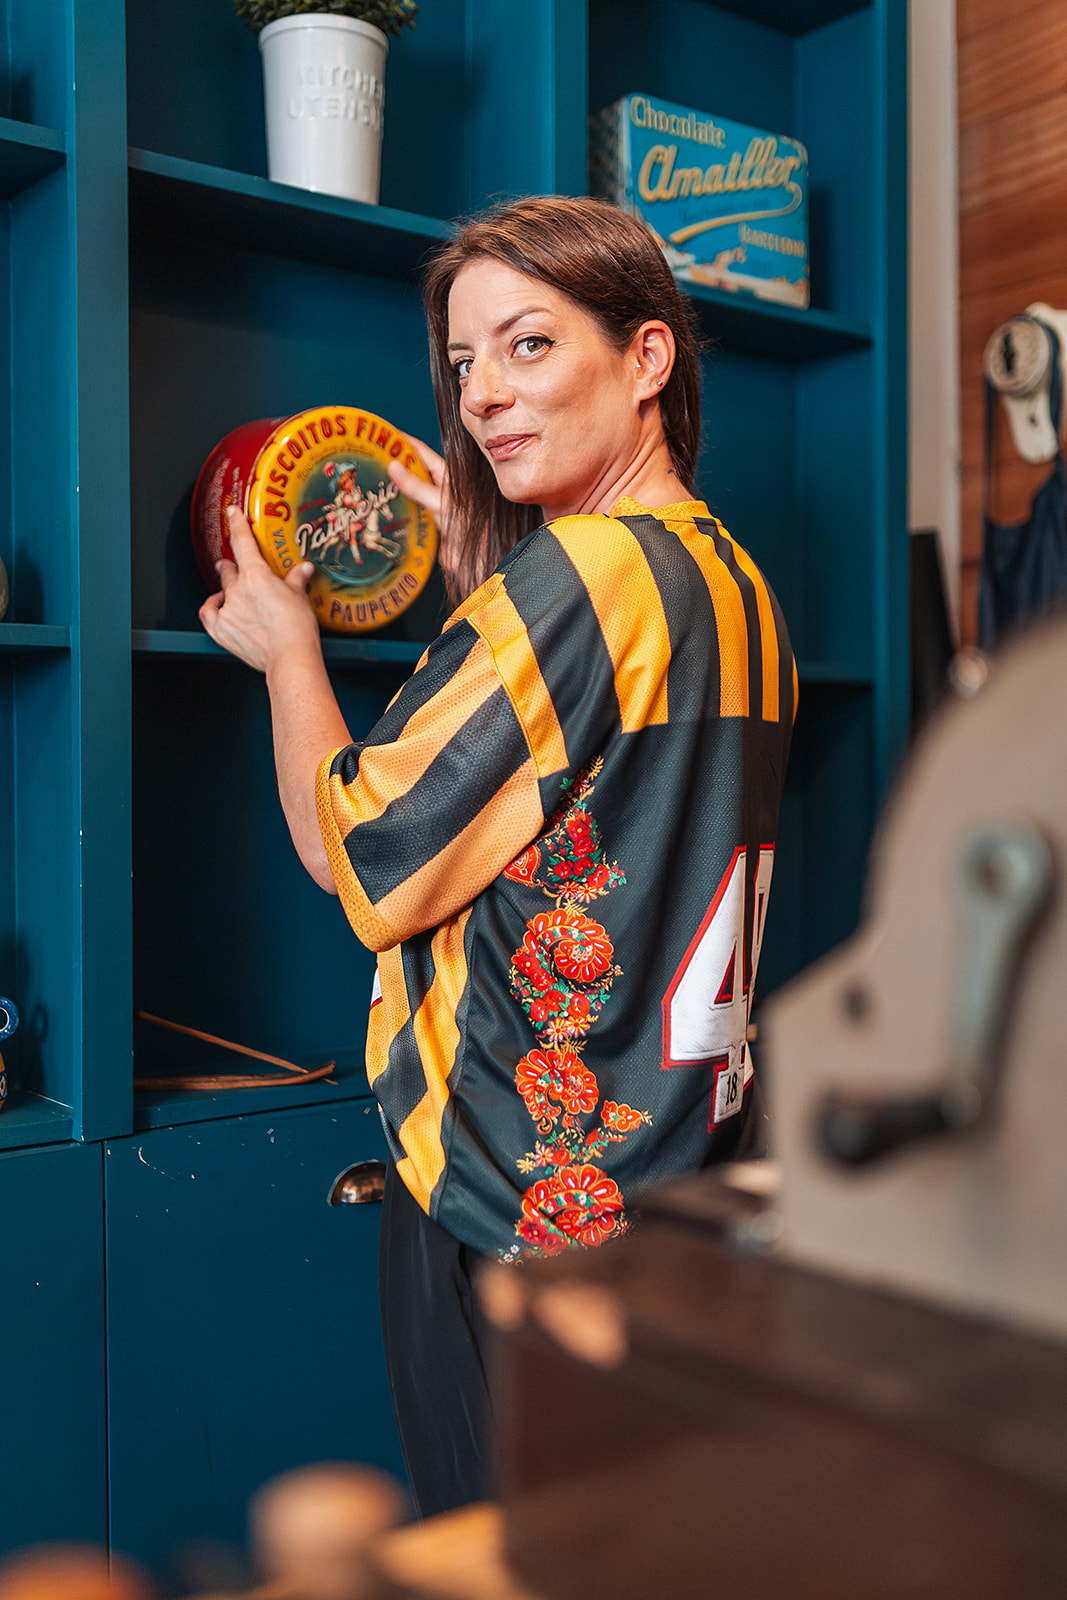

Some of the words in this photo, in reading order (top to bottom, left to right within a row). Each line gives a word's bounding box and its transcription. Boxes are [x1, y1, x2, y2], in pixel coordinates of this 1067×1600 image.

[630, 96, 726, 149] Chocolate
[264, 415, 347, 522] BISCOITOS
[724, 1071, 739, 1106] 18
